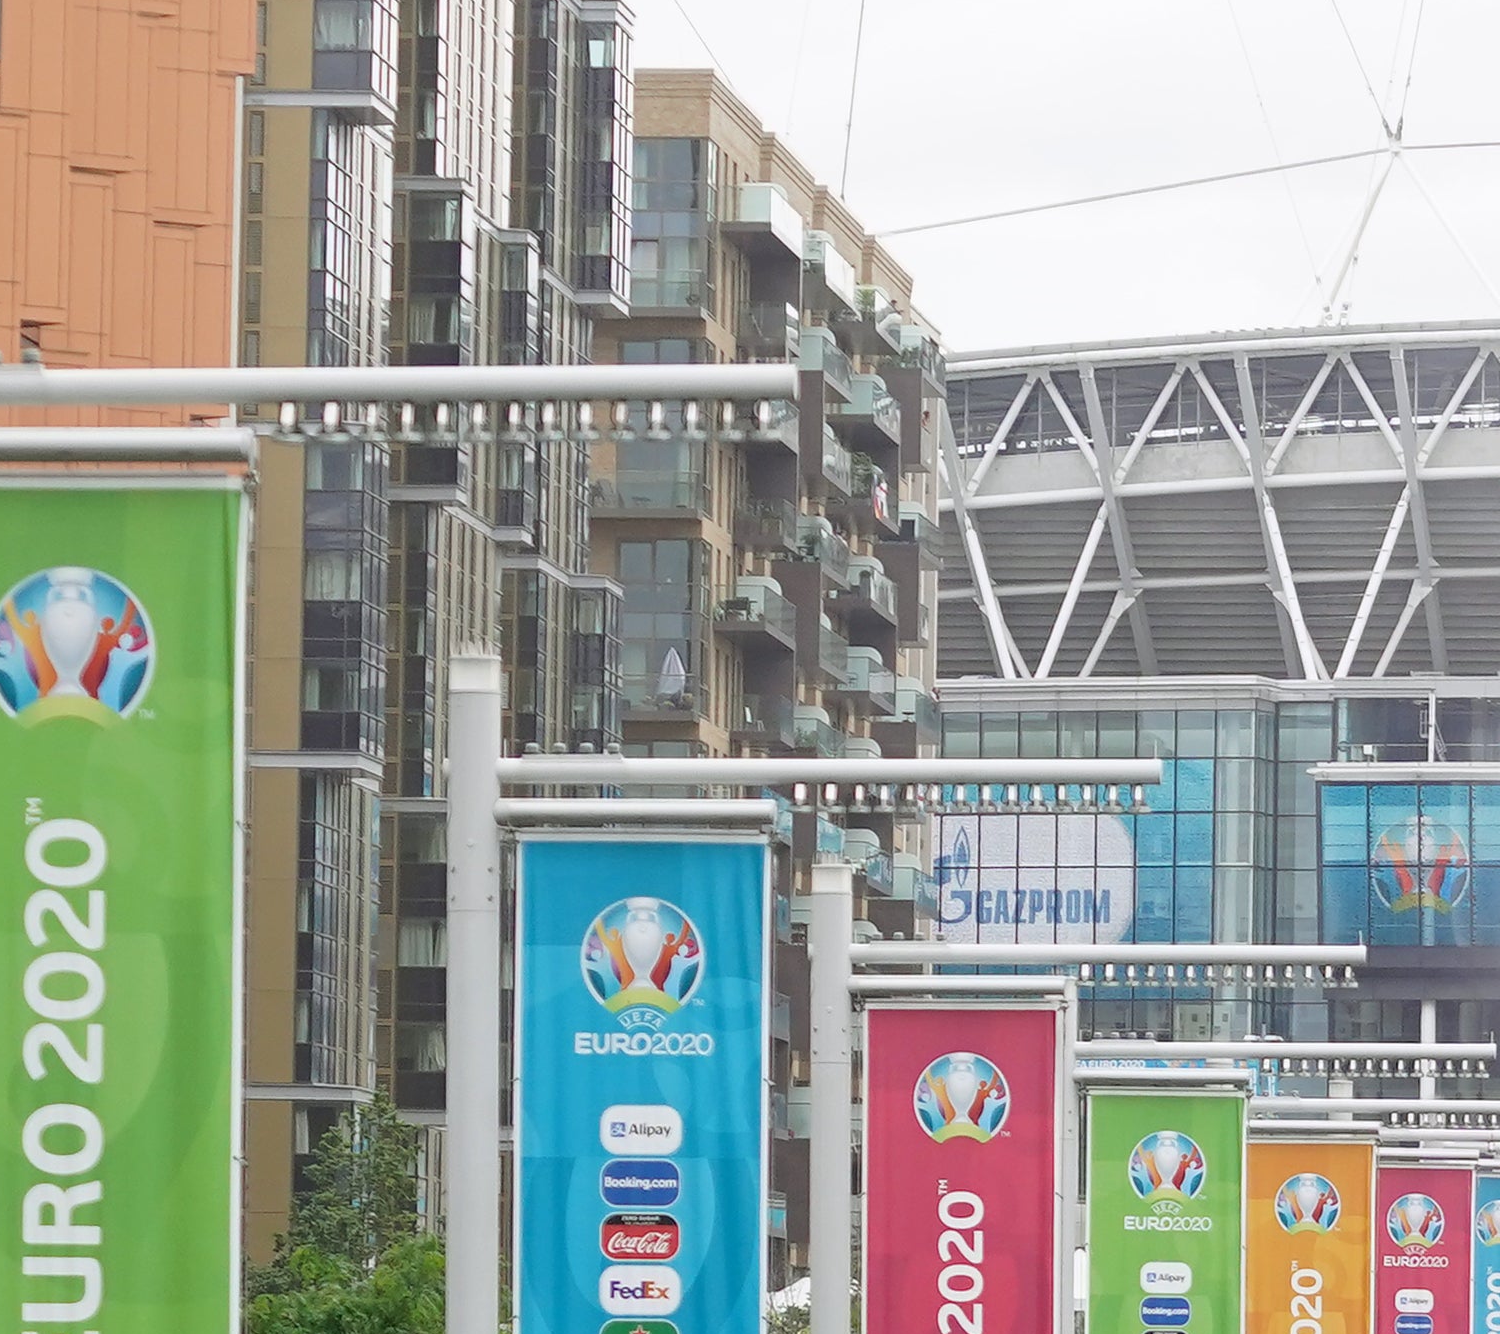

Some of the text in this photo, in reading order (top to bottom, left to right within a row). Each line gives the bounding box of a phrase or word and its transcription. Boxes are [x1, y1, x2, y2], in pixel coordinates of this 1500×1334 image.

[975, 889, 1111, 926] GAZPROM
[620, 1013, 664, 1028] UEFA
[574, 1032, 714, 1056] EURO2020
[629, 1122, 671, 1138] Alipay
[604, 1176, 677, 1191] Booking.com
[1124, 1216, 1212, 1231] EURO2020
[608, 1231, 673, 1254] Coca-Cola
[1384, 1255, 1449, 1267] EURO2020
[610, 1281, 670, 1299] FedEx
[1142, 1307, 1189, 1317] Booking.com
